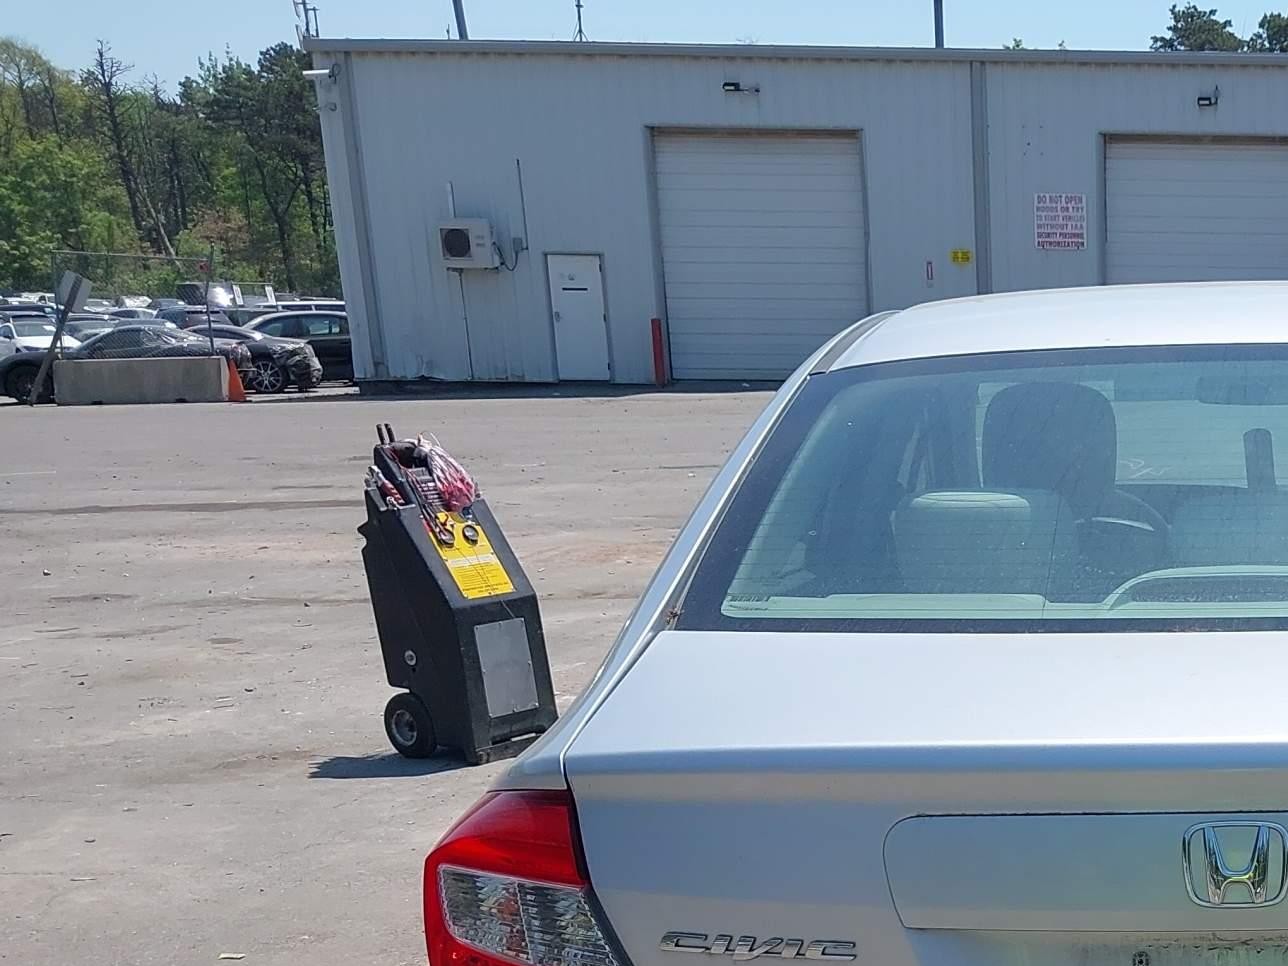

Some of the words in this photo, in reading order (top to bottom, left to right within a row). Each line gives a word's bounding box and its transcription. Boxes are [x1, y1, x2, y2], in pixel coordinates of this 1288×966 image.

[1037, 195, 1046, 204] DO
[1049, 195, 1062, 204] NOT
[1065, 195, 1082, 204] OPEN
[1037, 223, 1068, 231] WITHOUT
[1037, 240, 1084, 248] AUTHORIZATION
[659, 931, 857, 961] CIVIC
